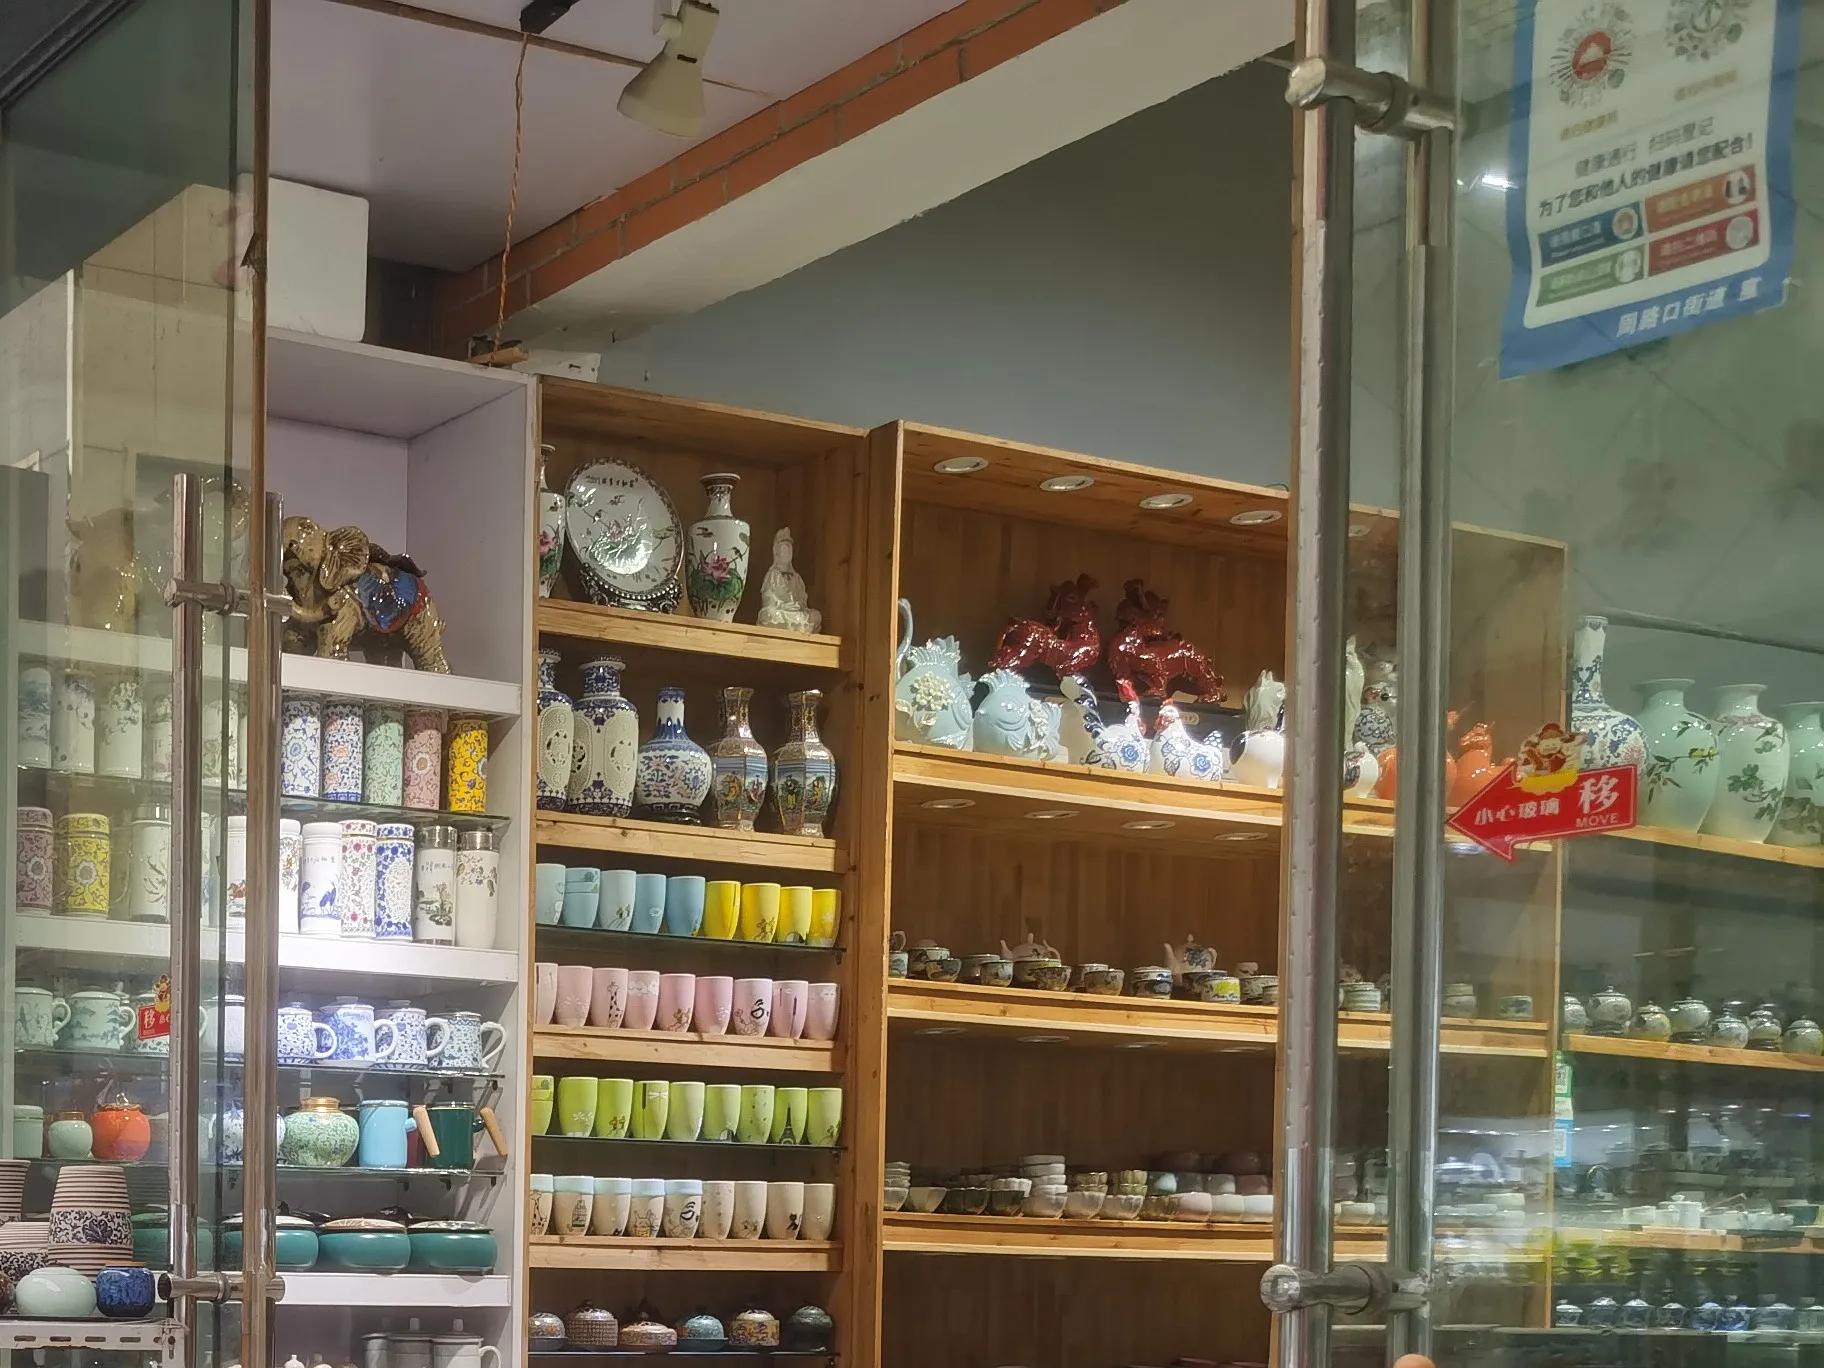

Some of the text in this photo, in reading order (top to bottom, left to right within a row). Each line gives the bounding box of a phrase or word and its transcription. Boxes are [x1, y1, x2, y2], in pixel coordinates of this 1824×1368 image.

[1578, 775, 1620, 814] 移
[1474, 797, 1560, 825] 小心玻璃
[1576, 812, 1619, 827] MOVE
